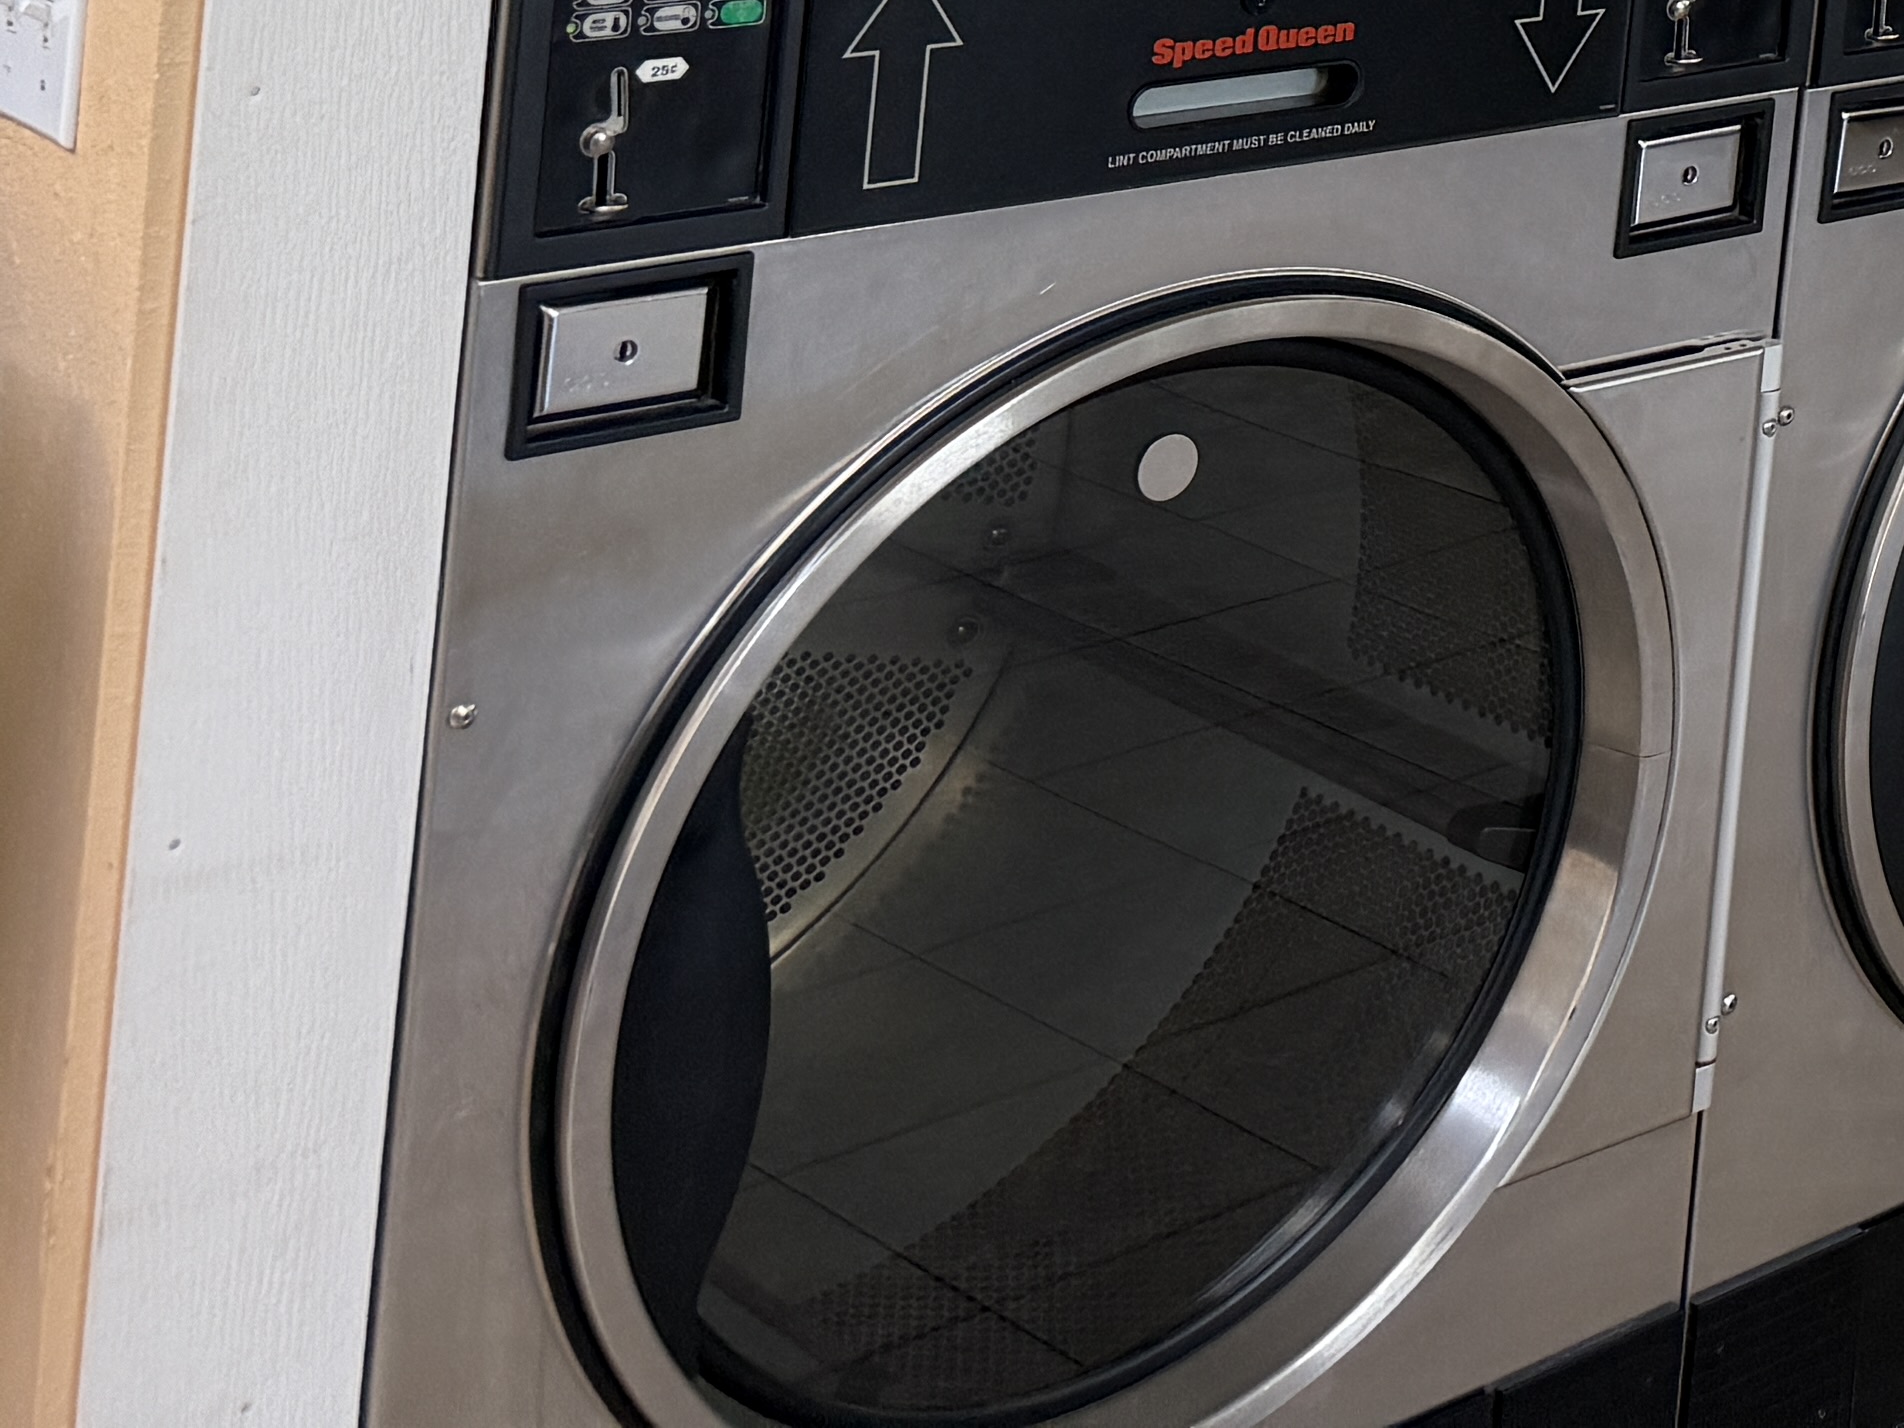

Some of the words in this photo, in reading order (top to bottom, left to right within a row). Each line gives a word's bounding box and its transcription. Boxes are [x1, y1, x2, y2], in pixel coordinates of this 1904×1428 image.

[1152, 27, 1256, 69] Speed
[1257, 21, 1356, 53] Queen
[1108, 153, 1137, 169] LINT
[1138, 140, 1231, 165] COMPARTMENT
[1232, 136, 1267, 152] MUST
[1268, 132, 1285, 147] BE
[1287, 124, 1342, 144] CLEANED
[1343, 119, 1377, 136] DAILY
